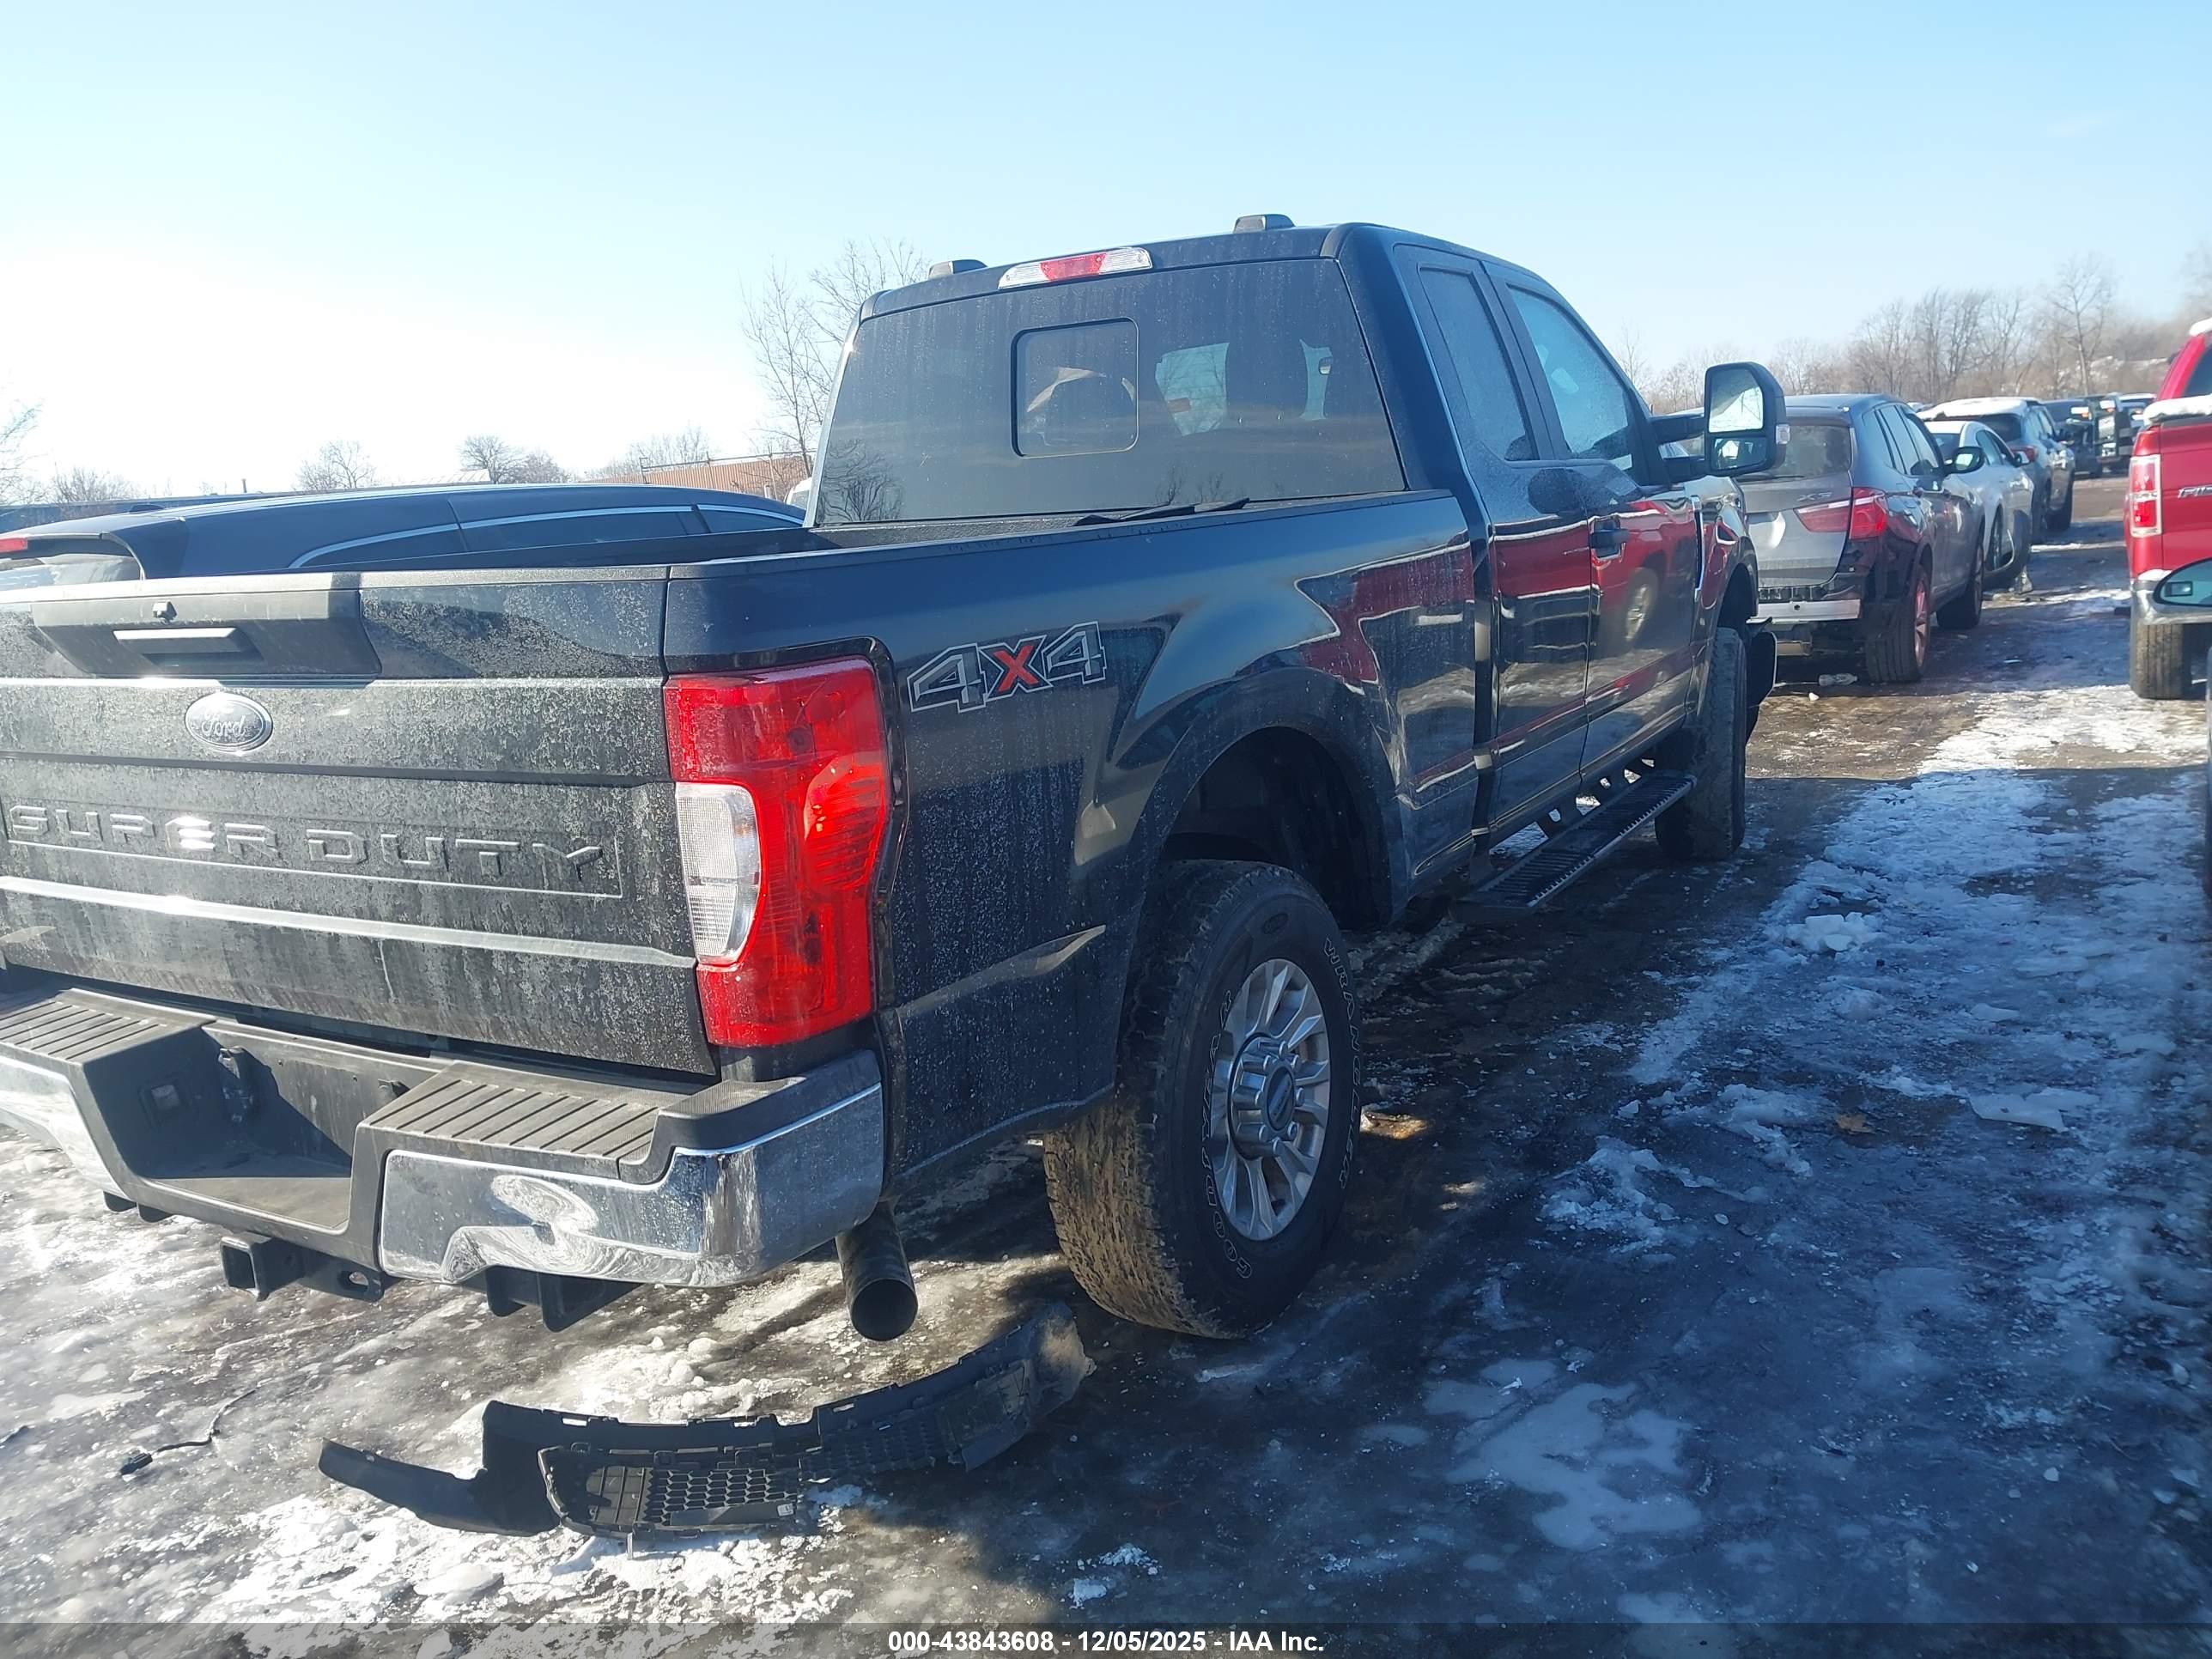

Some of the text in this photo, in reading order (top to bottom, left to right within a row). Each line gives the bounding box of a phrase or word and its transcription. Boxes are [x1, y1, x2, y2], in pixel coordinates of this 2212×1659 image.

[201, 711, 246, 738] Ford
[9, 805, 602, 882] SUPER DUTY
[1202, 990, 1253, 1279] GOODYEAR
[1323, 937, 1362, 1190] WRANGLER
